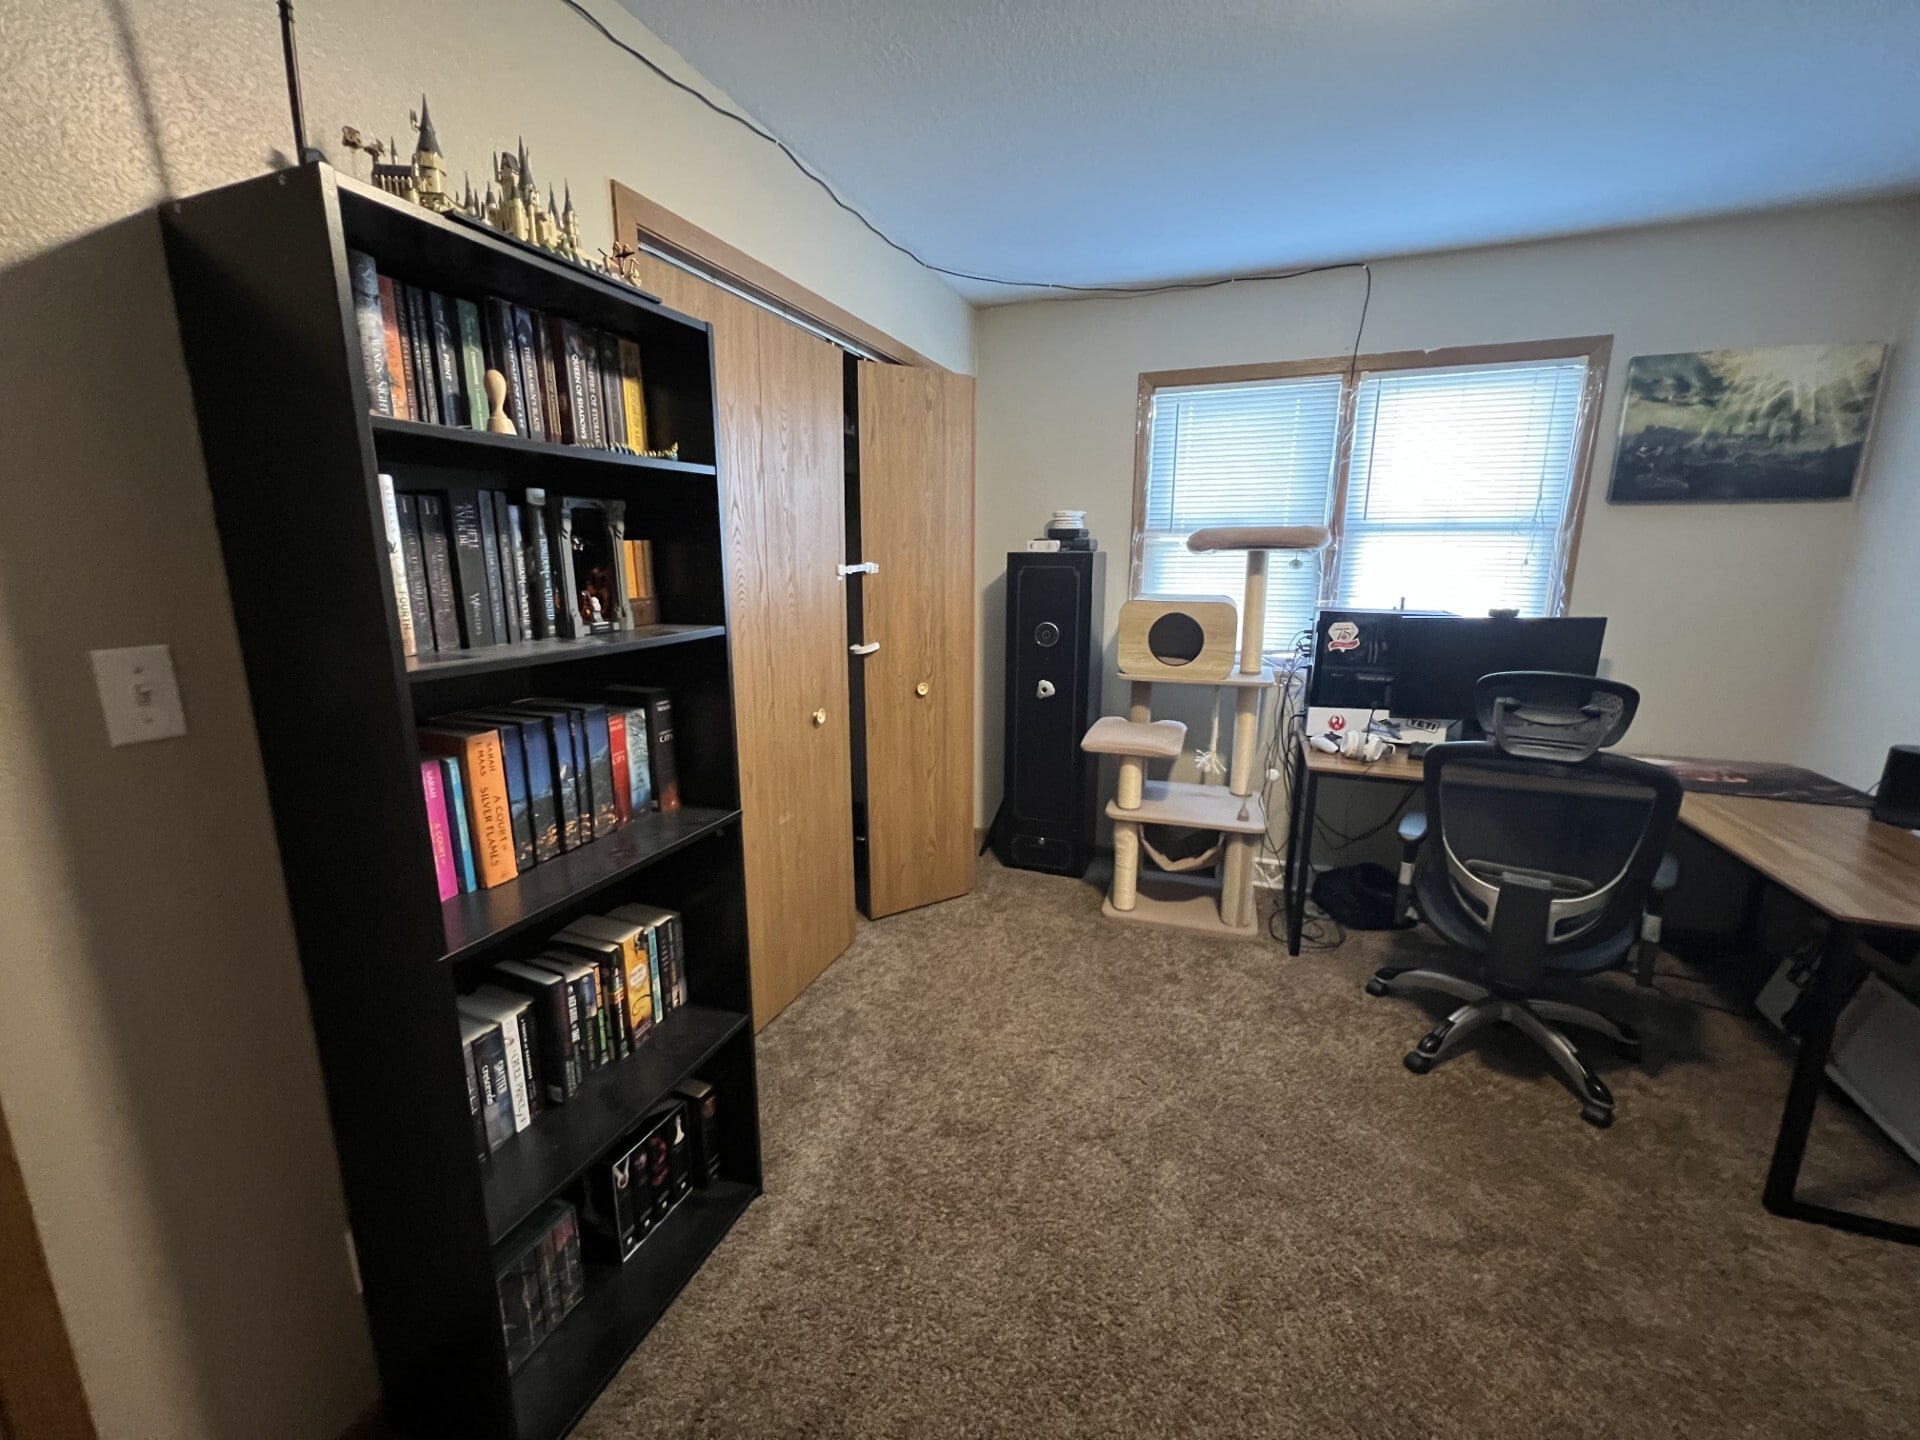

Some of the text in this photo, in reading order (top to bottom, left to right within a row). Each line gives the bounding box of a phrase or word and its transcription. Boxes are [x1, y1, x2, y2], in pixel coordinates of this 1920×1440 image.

[442, 352, 451, 382] PRINT
[571, 353, 587, 439] QUEEN OF SHADOWS
[589, 394, 596, 405] OF
[398, 590, 411, 631] FOURTH
[1335, 627, 1351, 641] 75
[1409, 718, 1437, 731] YETI
[476, 750, 486, 776] MAAS
[479, 786, 500, 866] SILVER FLAMES
[495, 805, 507, 842] COURT
